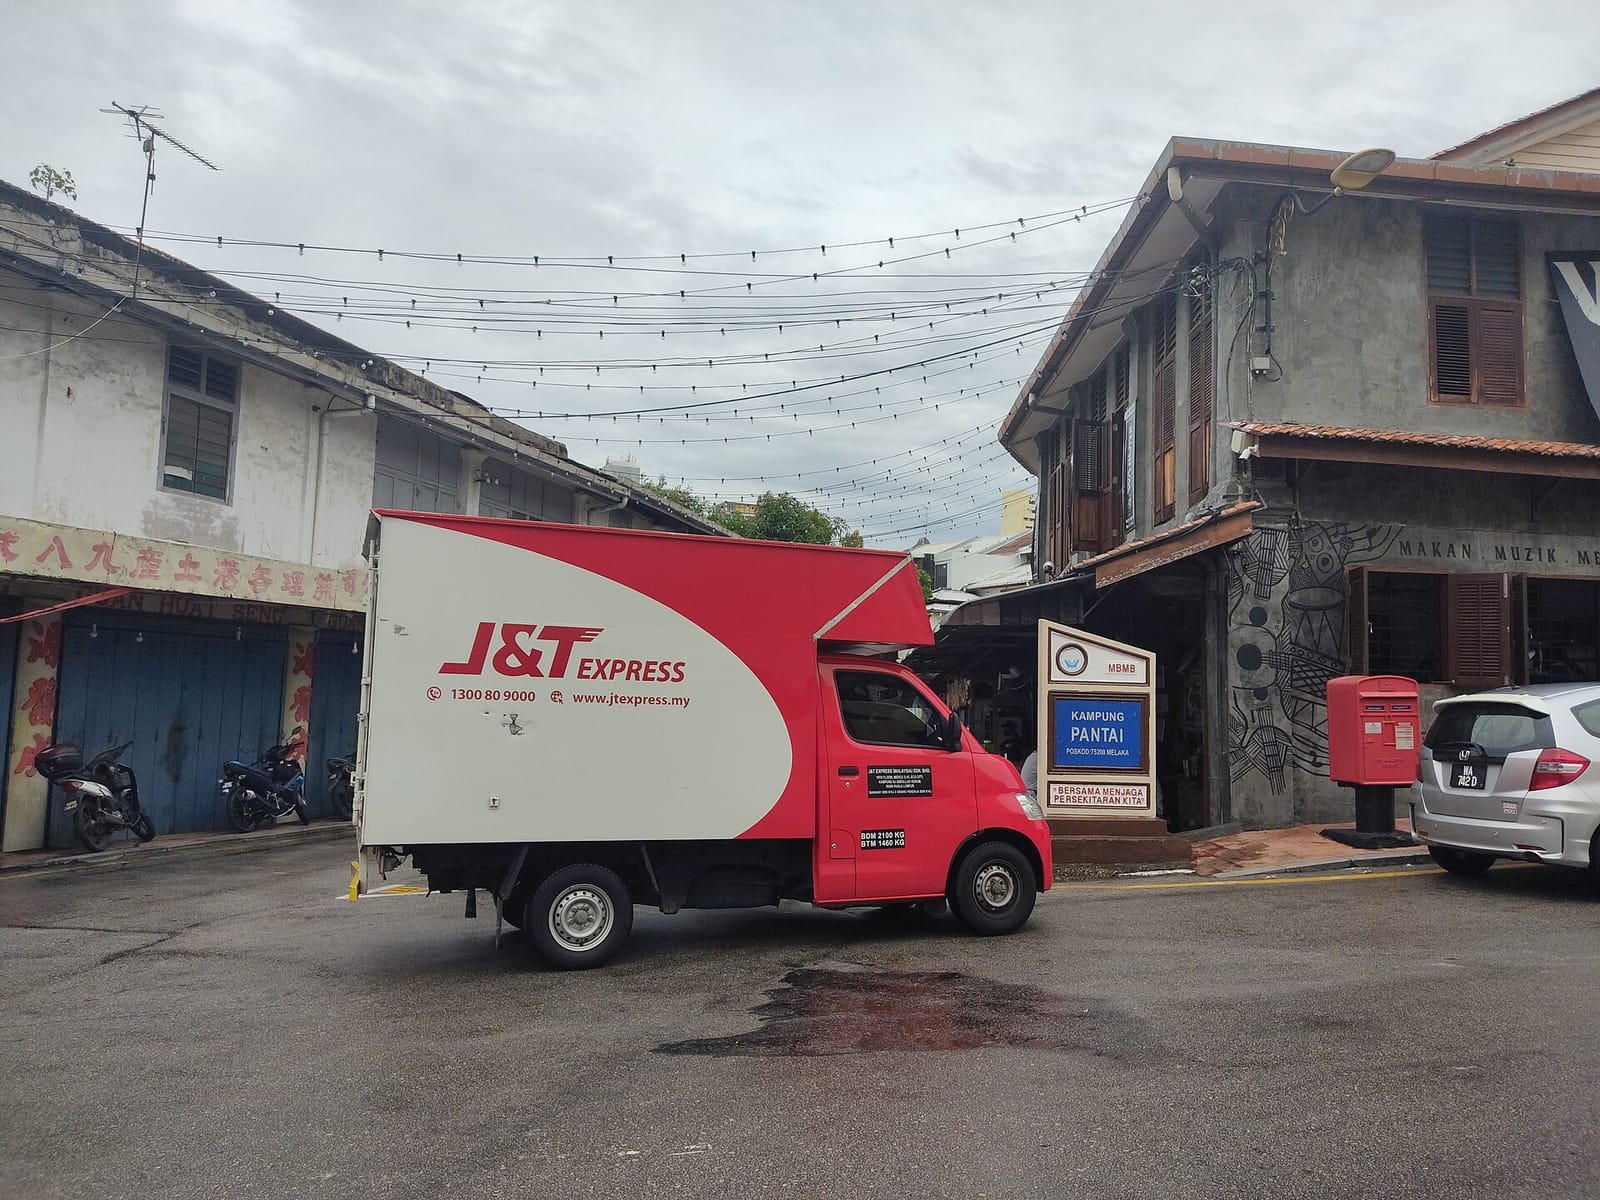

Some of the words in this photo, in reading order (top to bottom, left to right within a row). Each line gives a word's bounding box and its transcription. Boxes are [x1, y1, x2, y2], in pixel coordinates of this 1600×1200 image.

[1398, 540, 1472, 559] MAKAN
[1494, 545, 1557, 562] MUZIK
[159, 598, 217, 620] HUAT
[231, 603, 284, 624] SENG
[438, 621, 605, 679] J&T
[576, 657, 686, 683] EXPRESS
[1108, 663, 1136, 673] MBMB
[450, 688, 483, 701] 1300
[484, 689, 501, 702] 80
[503, 690, 536, 702] 9000
[572, 692, 691, 709] www.jtexpress.my
[1071, 710, 1125, 722] KAMPUNG
[1070, 726, 1124, 743] PANTAI
[1106, 748, 1130, 757] MELAKA
[1102, 787, 1144, 797] MENJAGA
[1054, 795, 1121, 805] PERSEKITARAN
[861, 832, 876, 840] BDM
[877, 831, 893, 839] 2100
[894, 831, 905, 839] KG
[861, 840, 876, 848] BTM
[878, 839, 893, 847] 1460
[894, 838, 905, 846] KG
